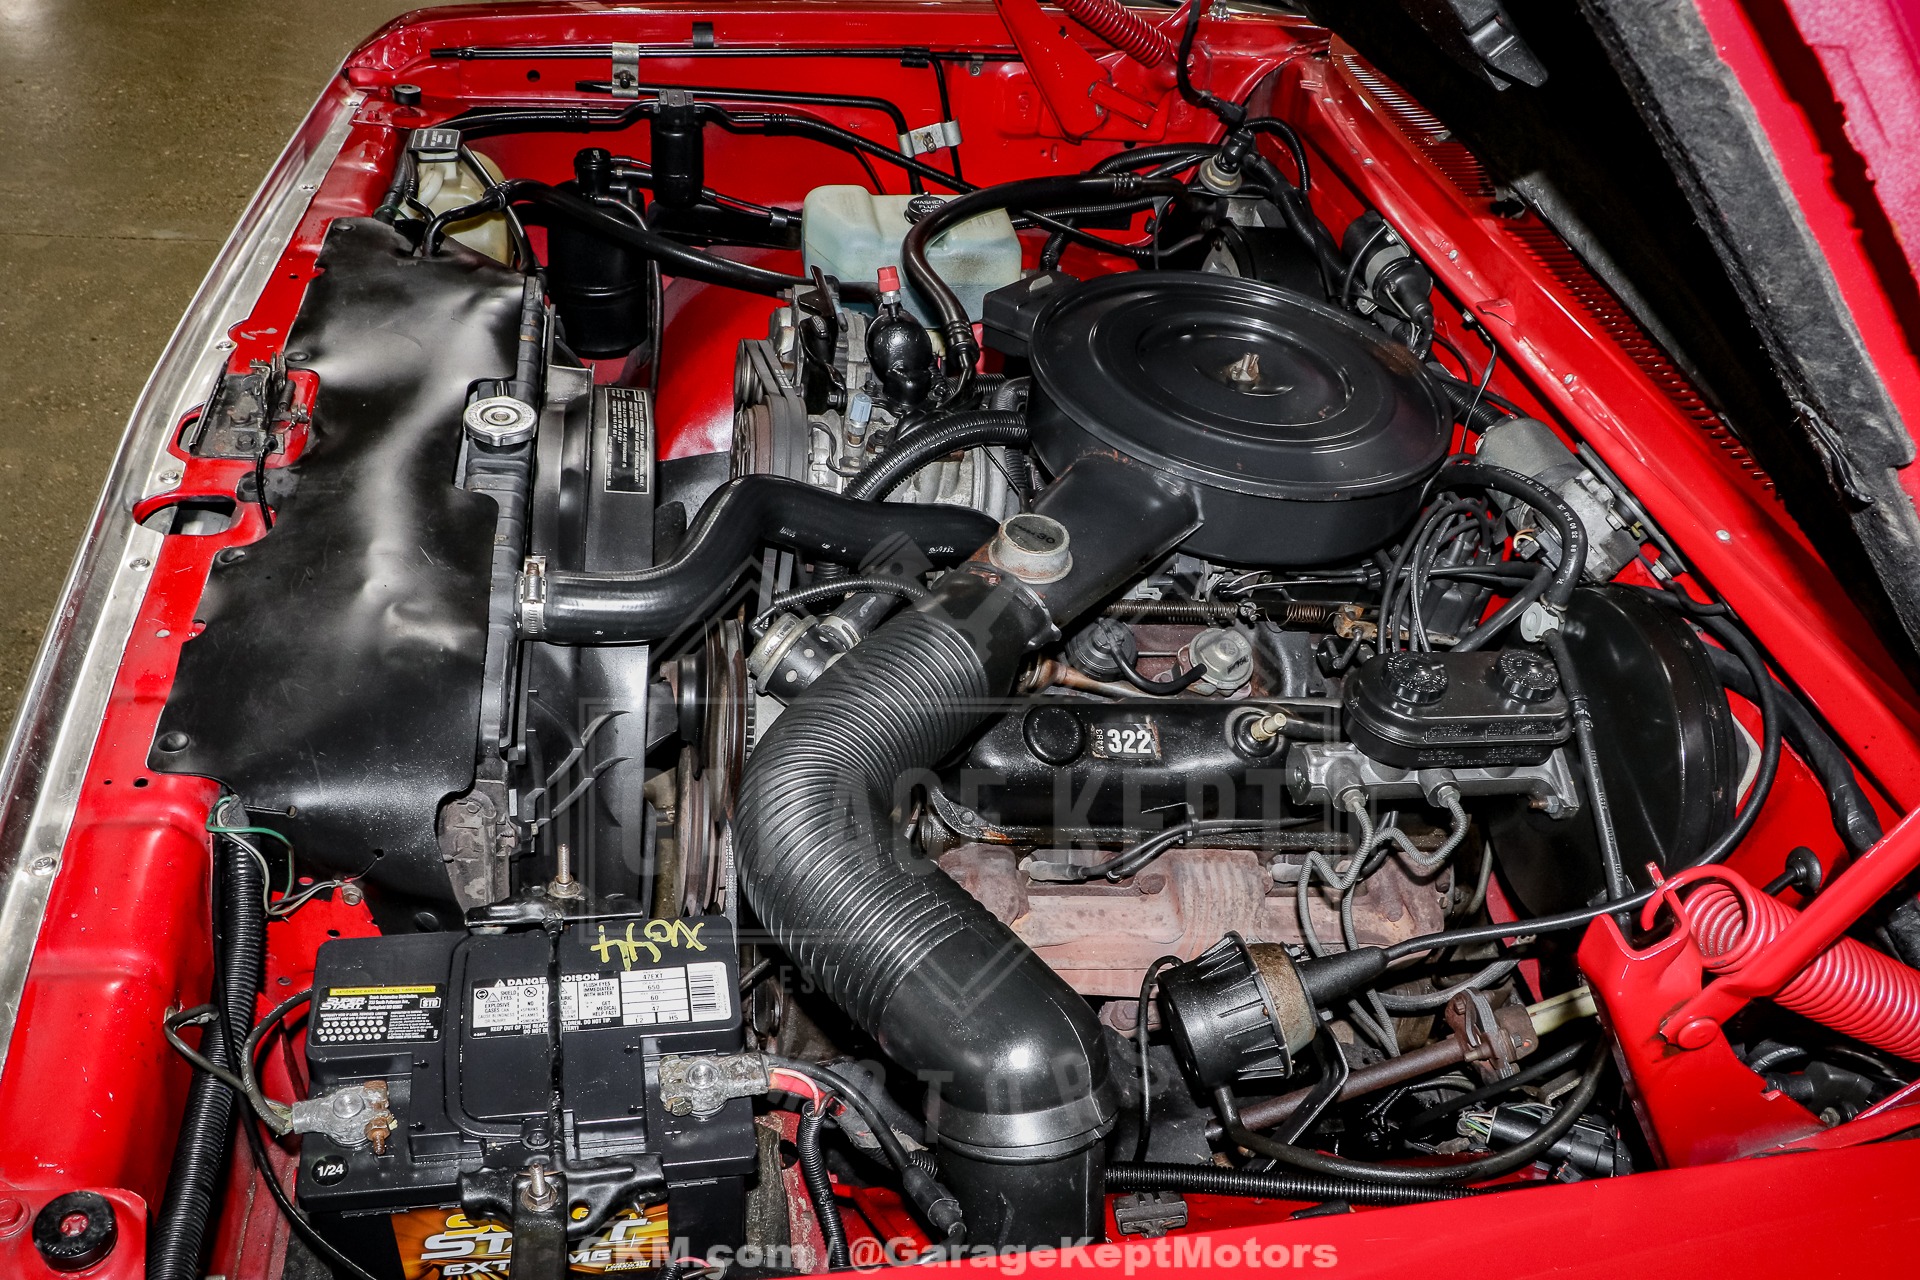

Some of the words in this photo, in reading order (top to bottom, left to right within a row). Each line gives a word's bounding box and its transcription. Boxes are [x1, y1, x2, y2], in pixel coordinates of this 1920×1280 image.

[1107, 728, 1152, 754] 322
[507, 977, 547, 986] DANGE
[317, 1163, 344, 1177] 1/24
